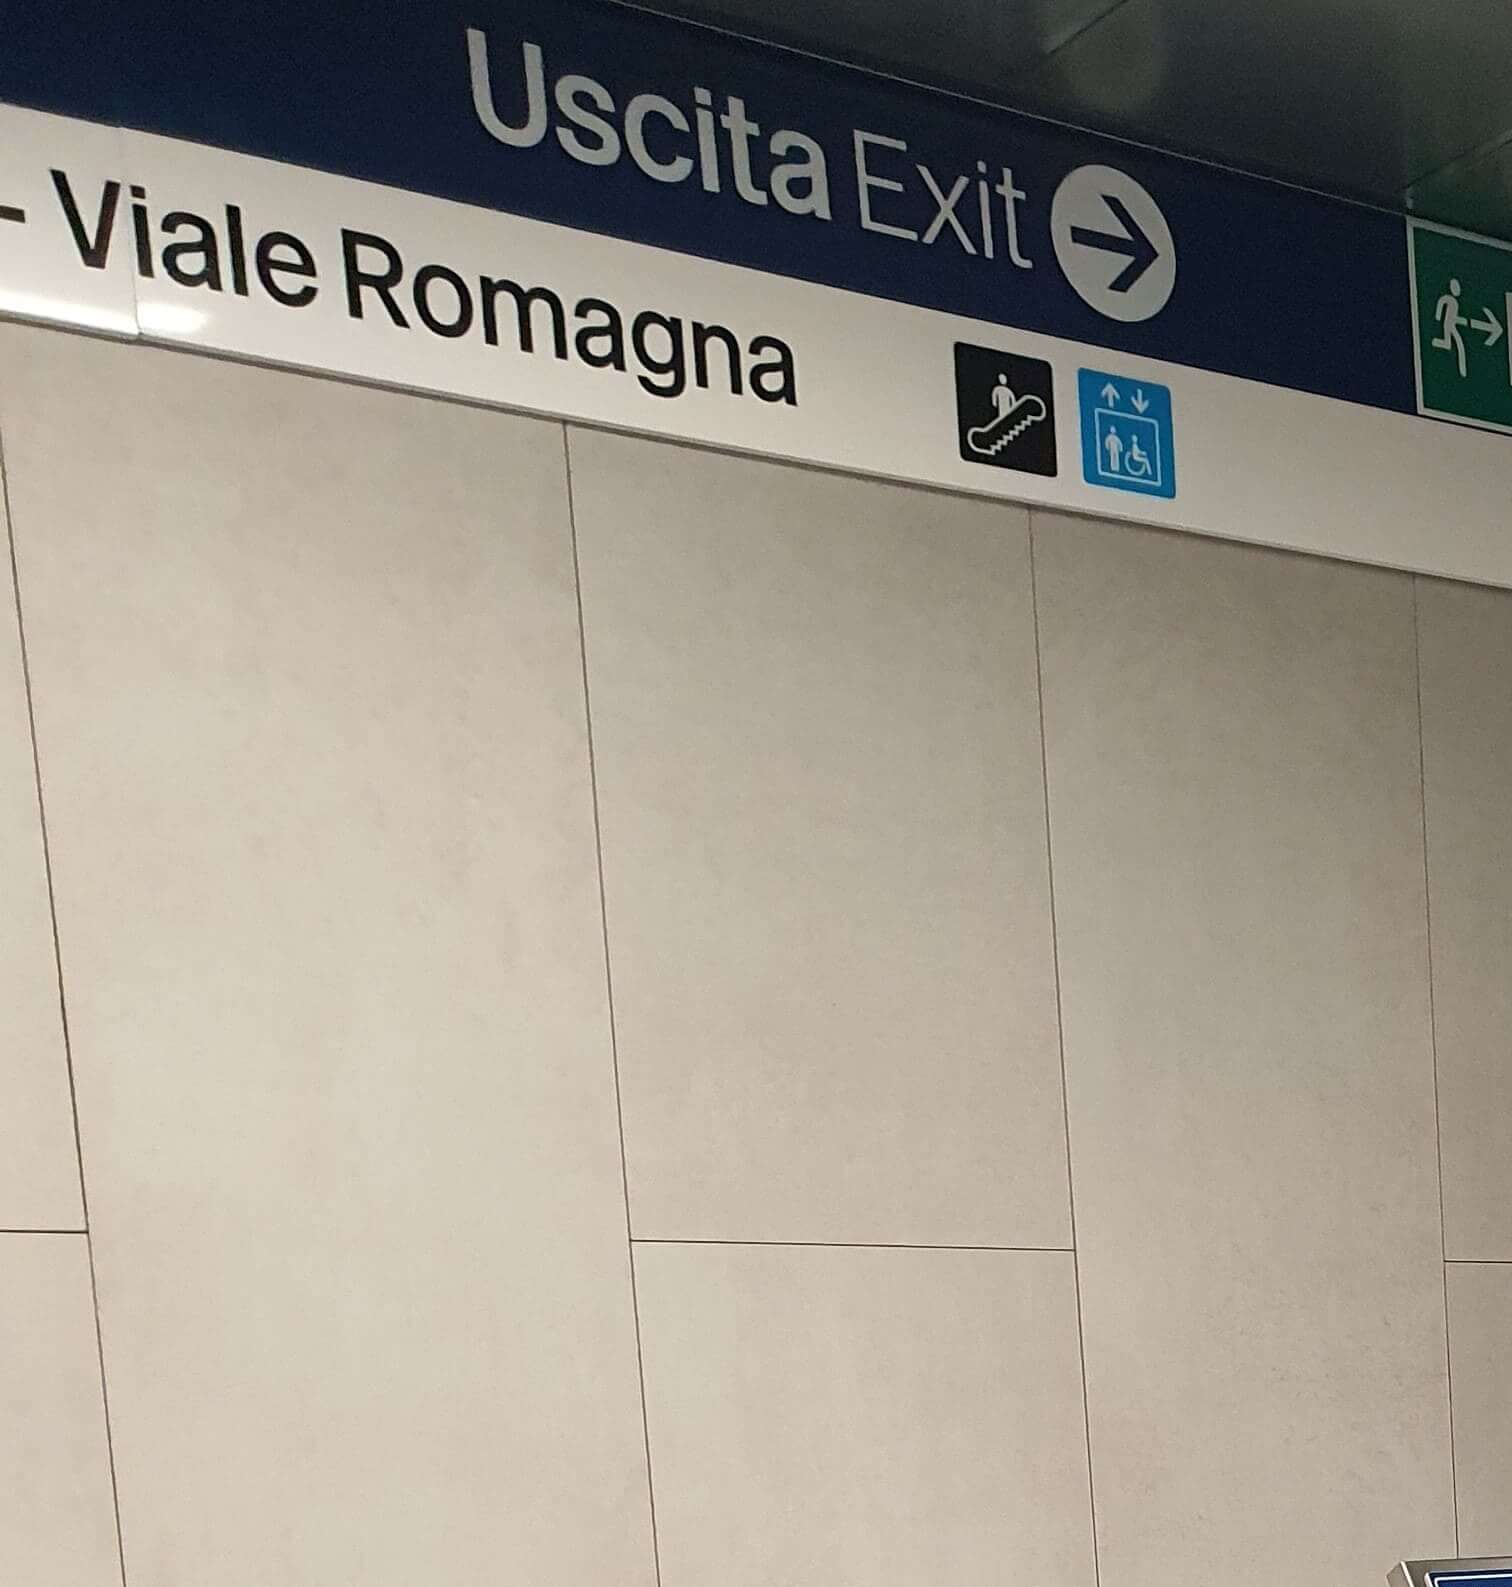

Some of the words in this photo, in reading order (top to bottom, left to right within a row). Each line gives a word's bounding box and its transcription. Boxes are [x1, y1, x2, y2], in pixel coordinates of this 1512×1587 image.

[466, 26, 832, 222] Uscita
[852, 128, 1033, 270] Exit
[48, 167, 319, 308] Viale
[341, 226, 800, 408] Romagna
